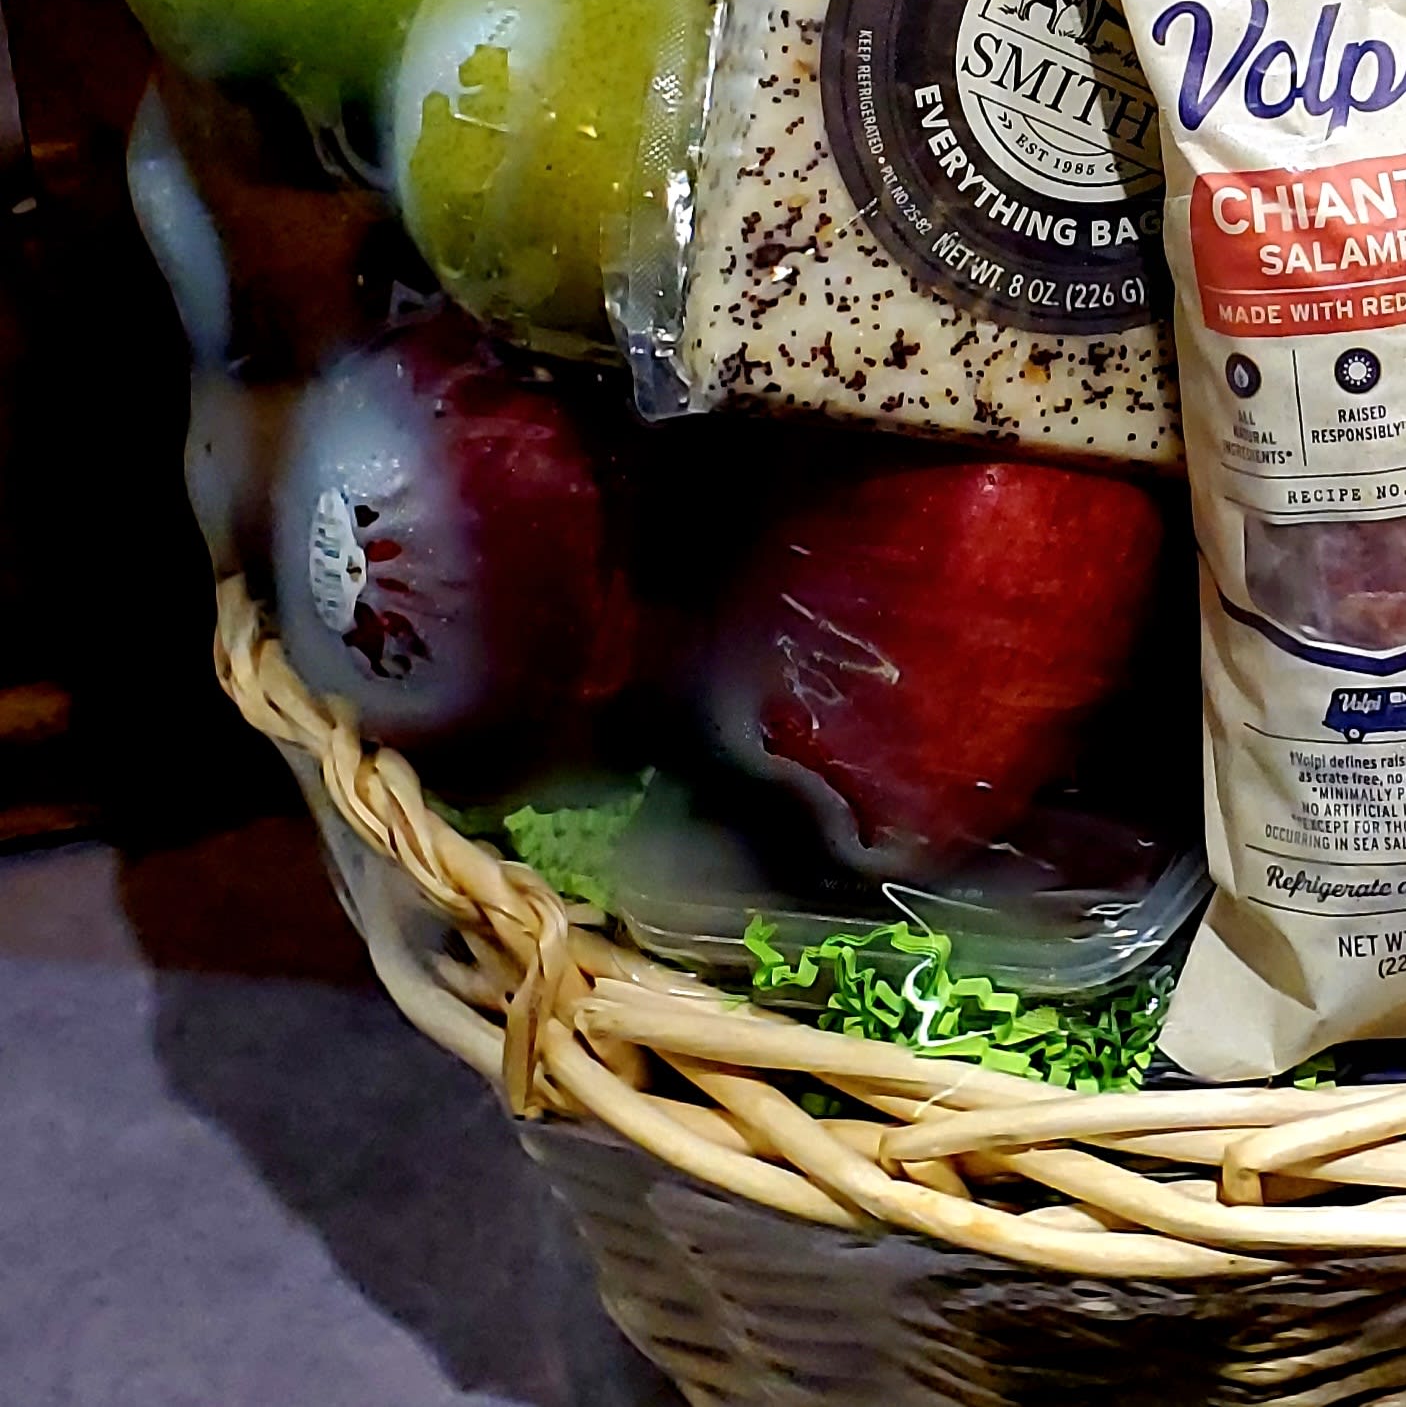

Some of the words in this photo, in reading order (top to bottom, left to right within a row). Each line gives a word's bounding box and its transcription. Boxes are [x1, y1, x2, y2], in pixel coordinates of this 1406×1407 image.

[857, 29, 873, 62] KEEP
[961, 32, 1160, 150] SMITH
[857, 65, 884, 155] REFRIGERATED
[914, 83, 1077, 246] EVERYTHING
[1015, 133, 1049, 162] EST
[1053, 157, 1096, 176] 1985
[903, 204, 933, 235] 25-82
[931, 232, 974, 271] NET
[967, 256, 1006, 292] WT.
[1008, 274, 1024, 298] 8
[1065, 283, 1115, 311] (226
[1121, 277, 1145, 305] G)
[1218, 304, 1283, 325] MADE
[1290, 299, 1353, 322] WITH
[1337, 405, 1386, 423] RAISED
[1287, 488, 1362, 505] RECIPE
[1339, 692, 1381, 714] Volpi
[1329, 755, 1377, 769] defines
[1298, 772, 1312, 783] as
[1316, 772, 1349, 784] crate
[1352, 772, 1383, 786] free,
[1387, 772, 1403, 784] no
[1302, 802, 1319, 816] NO
[1324, 802, 1398, 818] ARTIFICIAL
[1265, 824, 1330, 850] OCCURRING
[1335, 837, 1348, 851] IN
[1353, 836, 1379, 851] SEA
[1354, 820, 1380, 834] FOR
[1266, 865, 1392, 903] Refrigerate
[1338, 934, 1378, 958] NET
